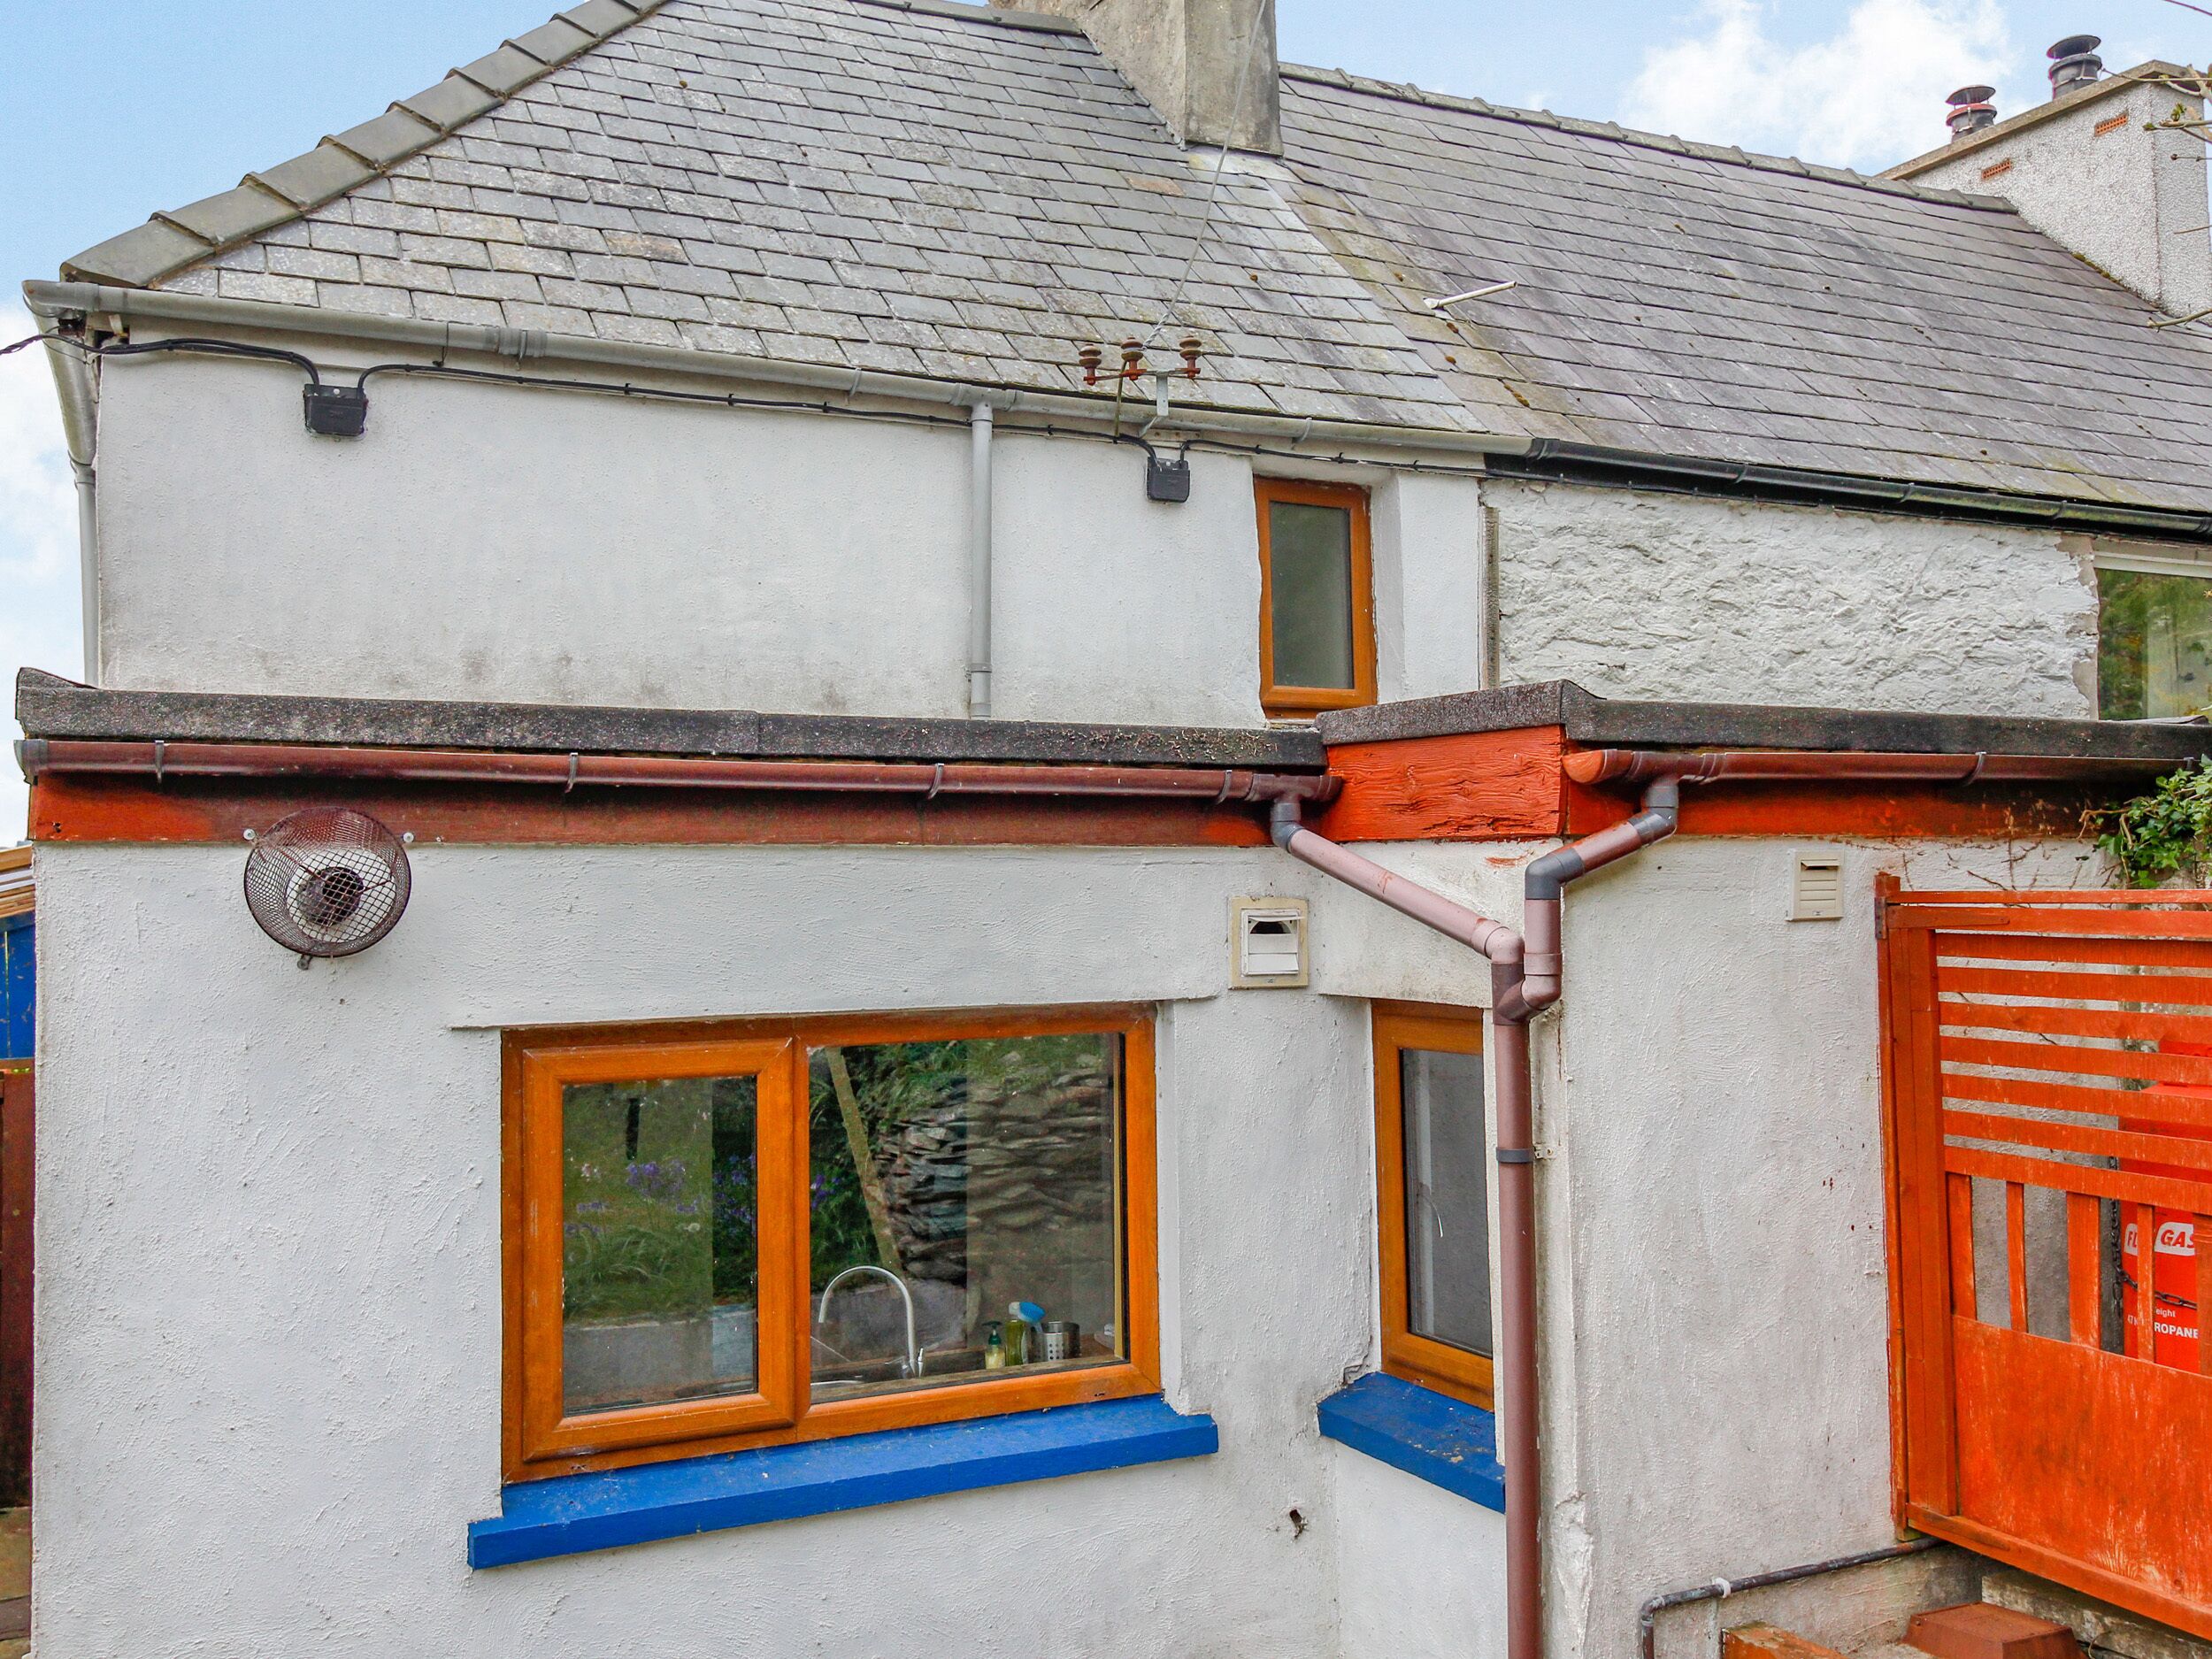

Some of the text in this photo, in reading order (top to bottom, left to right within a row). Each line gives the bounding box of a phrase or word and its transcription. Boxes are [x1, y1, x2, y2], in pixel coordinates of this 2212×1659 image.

[2127, 1231, 2138, 1248] FL
[2155, 1308, 2176, 1318] eight
[2154, 1321, 2199, 1339] ROPANE
